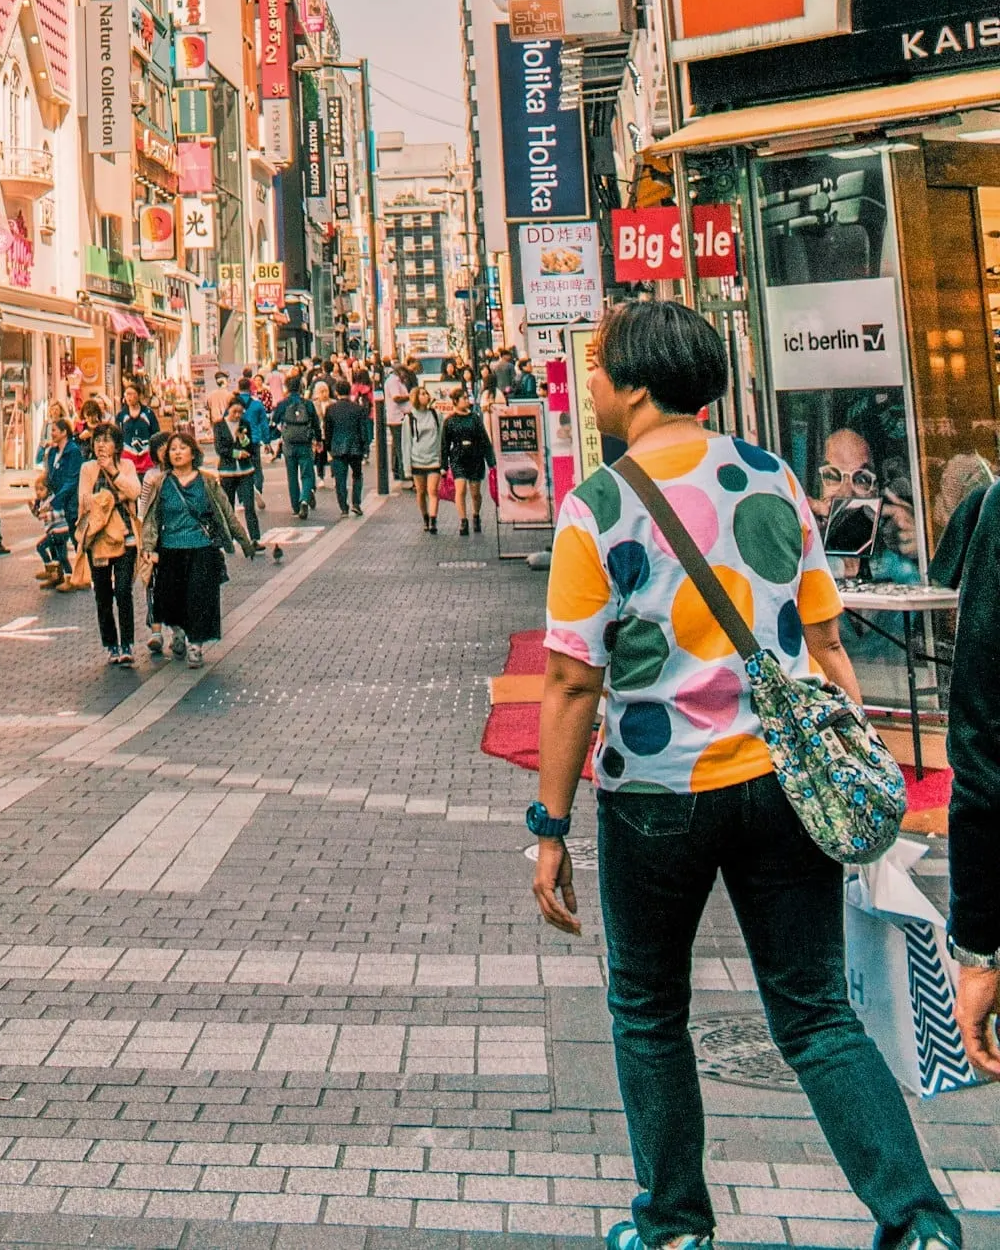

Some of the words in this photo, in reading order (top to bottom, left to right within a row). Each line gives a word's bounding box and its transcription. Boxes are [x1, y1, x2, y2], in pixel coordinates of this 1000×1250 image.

[99, 4, 113, 60] Nature
[515, 22, 559, 35] mall
[100, 65, 114, 146] Collection
[272, 83, 285, 95] 3F
[308, 120, 319, 153] HOLLYS
[310, 162, 320, 195] COFFEE
[527, 124, 558, 213] Holika
[186, 210, 207, 237] 光
[619, 225, 664, 268] Big
[258, 265, 280, 278] BIG
[784, 332, 804, 353] ic!
[808, 328, 859, 351] berlin
